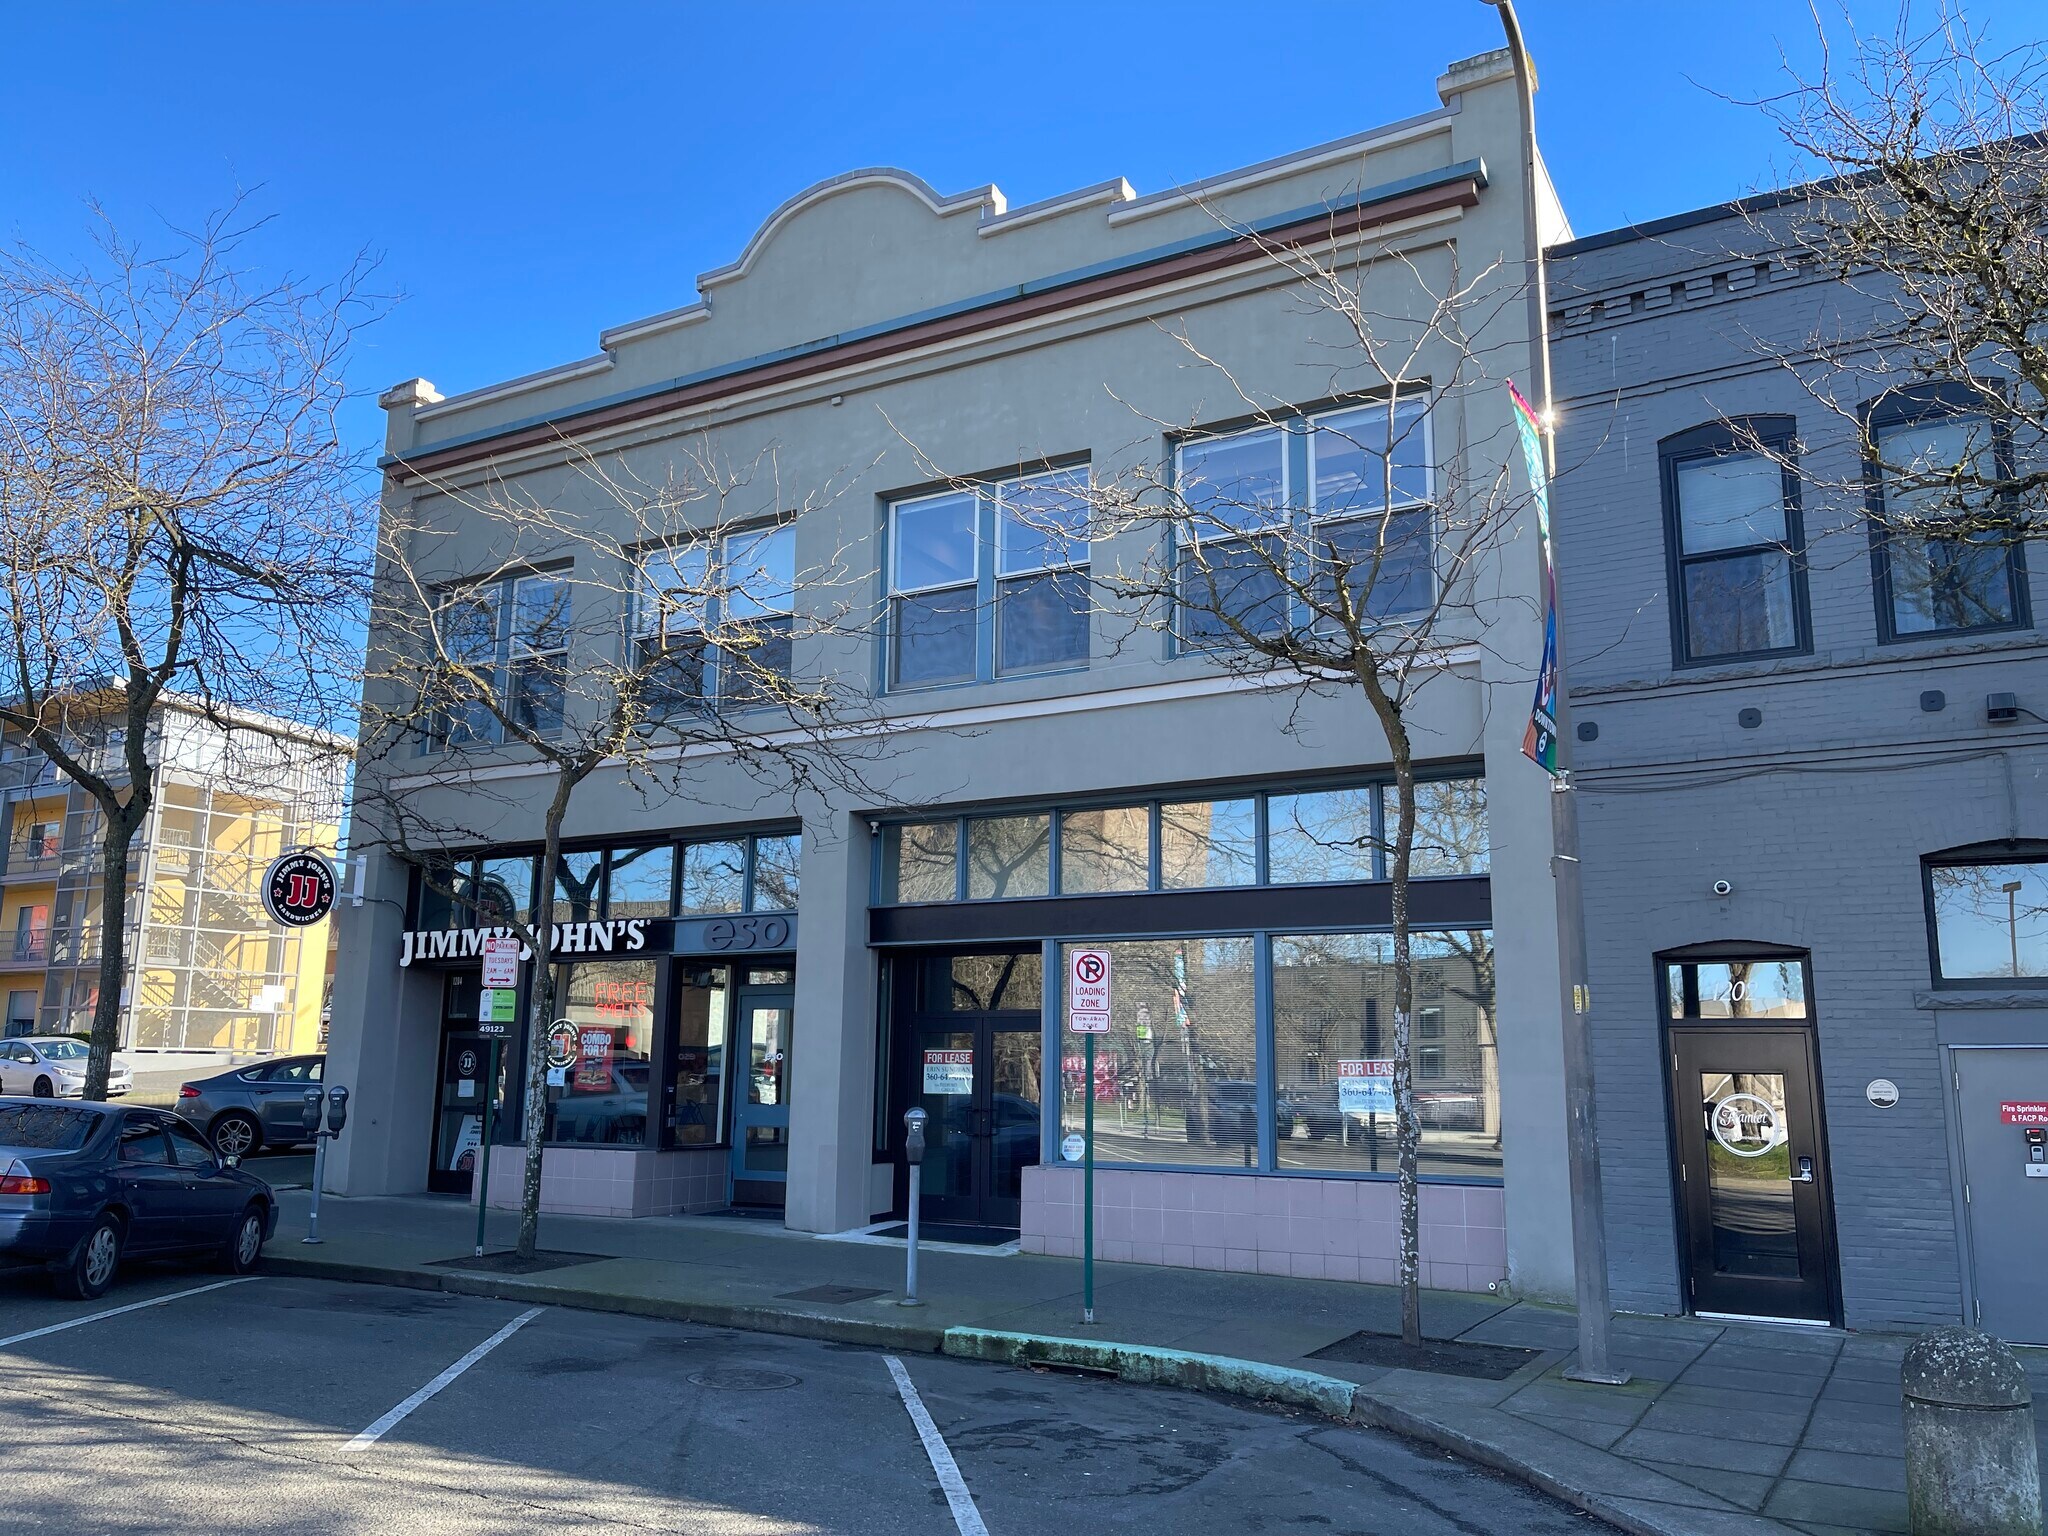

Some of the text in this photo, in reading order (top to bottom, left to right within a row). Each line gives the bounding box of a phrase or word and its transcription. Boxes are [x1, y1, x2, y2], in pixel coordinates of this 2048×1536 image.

[277, 860, 330, 888] JIMMY JOHN'S
[286, 874, 319, 908] JJ
[278, 904, 323, 921] SANDWICHES
[703, 916, 788, 950] eso
[486, 941, 517, 951] NO PARKING
[594, 982, 648, 1003] FREE
[1076, 987, 1105, 996] LOADING
[1713, 981, 1757, 1001] 1202
[594, 1002, 647, 1018] SMELLS
[1080, 999, 1100, 1008] ZONE
[479, 1025, 505, 1033] 49123
[580, 1033, 612, 1045] COMBO
[582, 1044, 600, 1056] FOR
[927, 1053, 971, 1063] FOR LEASE
[1340, 1063, 1394, 1076] FOR LEAS
[2002, 1104, 2046, 1113] Fire Sprinkler
[1719, 1109, 1768, 1126] Hamlet
